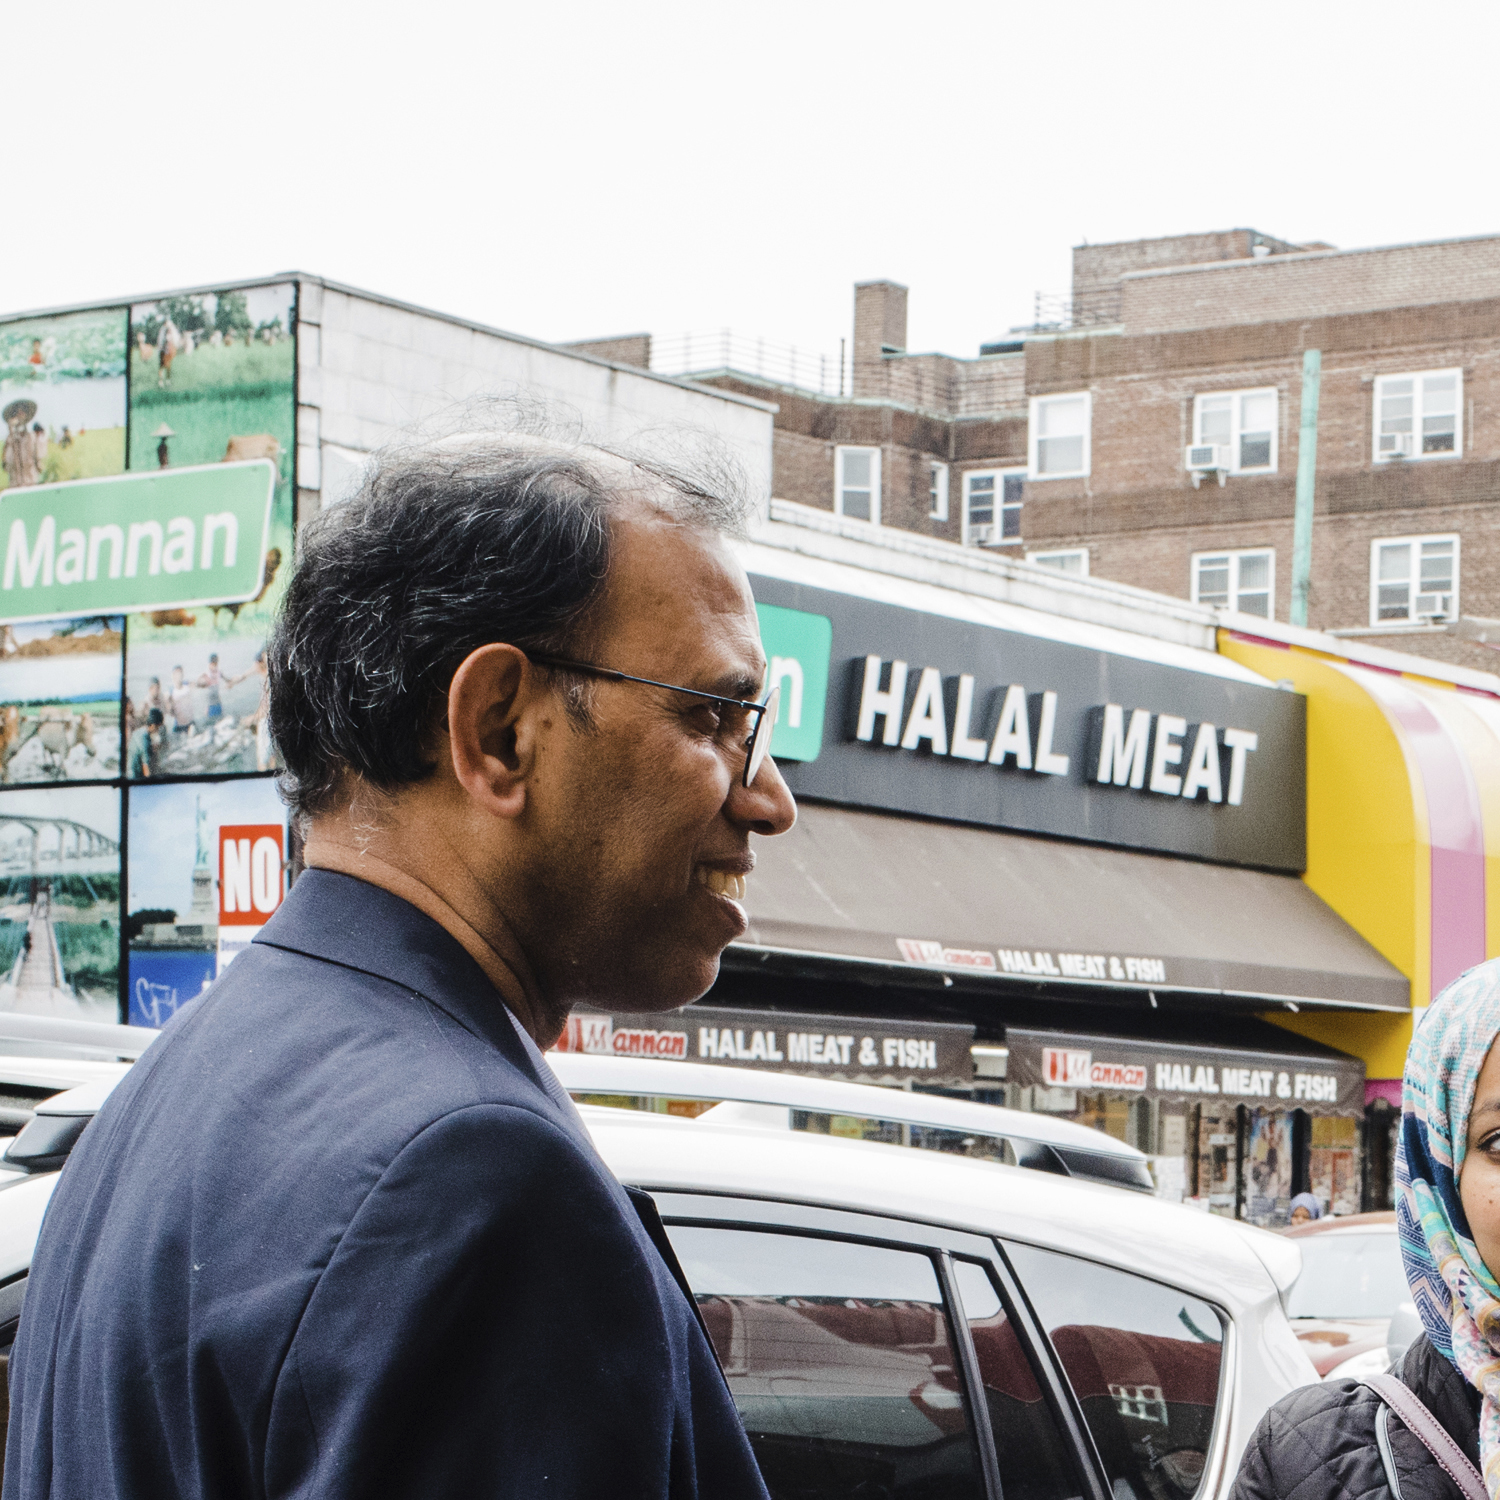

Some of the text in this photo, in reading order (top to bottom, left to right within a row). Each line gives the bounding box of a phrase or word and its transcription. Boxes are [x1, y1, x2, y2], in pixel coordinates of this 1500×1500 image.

[2, 511, 239, 590] Mannan
[856, 654, 1069, 776] HALAL
[1097, 703, 1258, 806] MEAT
[223, 836, 280, 913] NO
[998, 949, 1060, 976] HALAL
[1057, 953, 1106, 979] MEAT
[1110, 956, 1124, 980] &
[1125, 957, 1166, 982] FISH
[585, 1017, 938, 1069] Mannan HALAL MEAT & FISH
[1155, 1063, 1219, 1093] HALAL
[1221, 1067, 1273, 1097] MEAT
[1276, 1071, 1291, 1098] &
[1295, 1073, 1337, 1101] FISH
